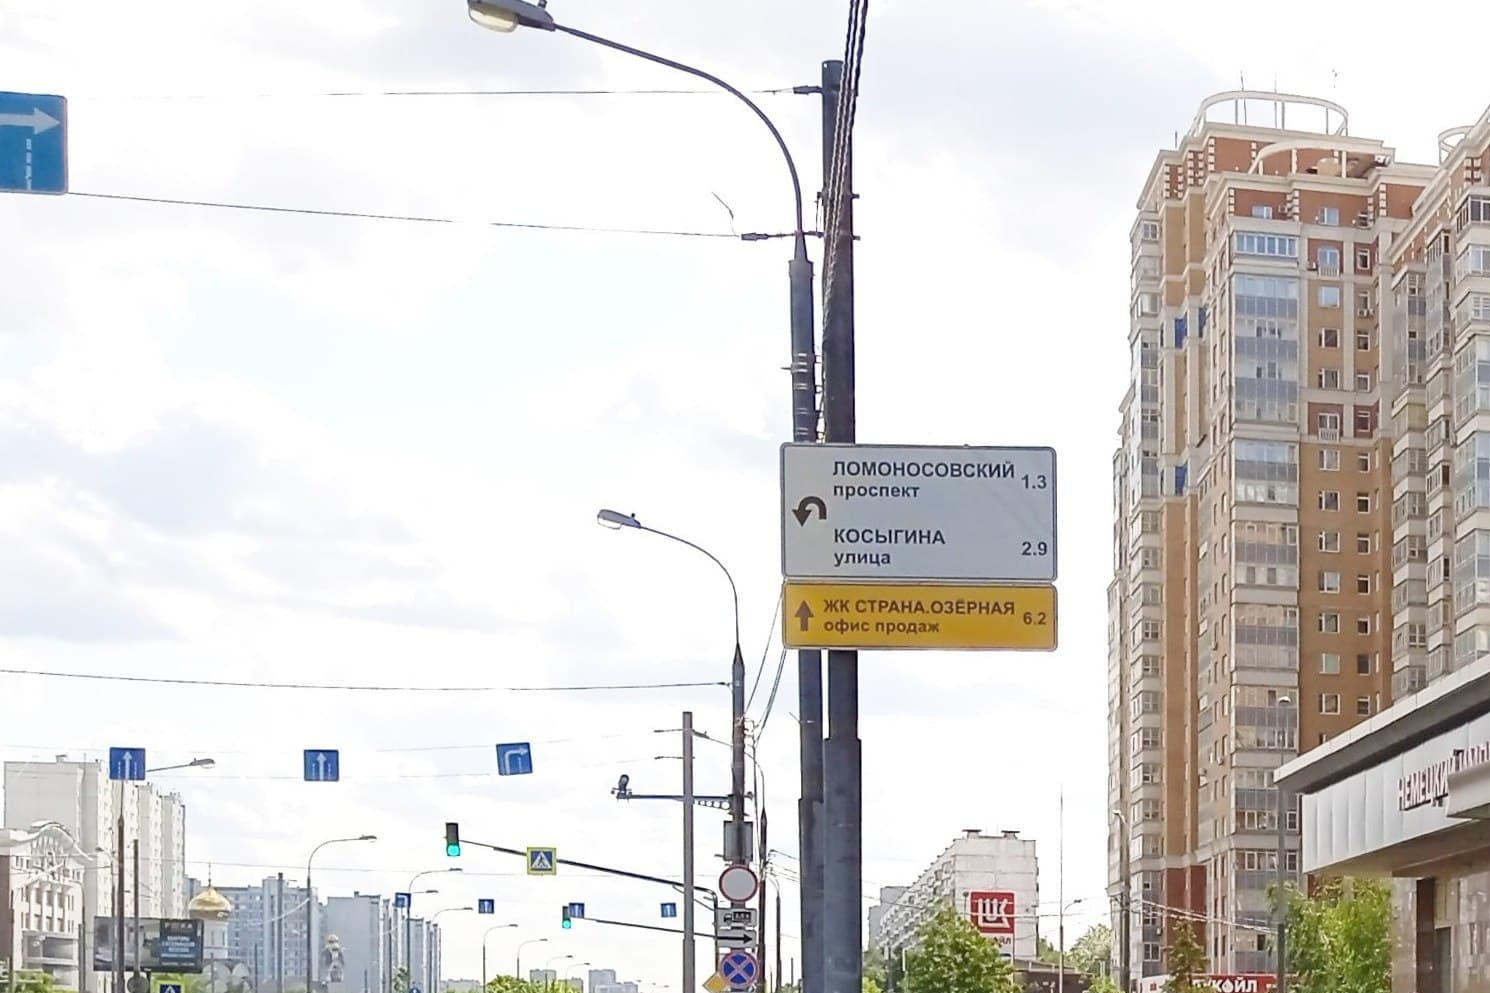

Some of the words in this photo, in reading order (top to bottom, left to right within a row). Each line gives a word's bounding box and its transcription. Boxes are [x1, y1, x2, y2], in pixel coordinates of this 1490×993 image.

[833, 460, 1015, 479] ЛОМОНОСОВСКИЙ
[1021, 474, 1047, 489] 1.3
[833, 484, 920, 500] проспект
[834, 528, 946, 545] КОСЫГИНА
[1021, 541, 1047, 556] 2.9
[834, 552, 891, 567] улица
[823, 599, 849, 613] ЖК
[1023, 612, 1047, 626] 6.2
[823, 620, 870, 633] офис
[875, 622, 940, 634] продаж
